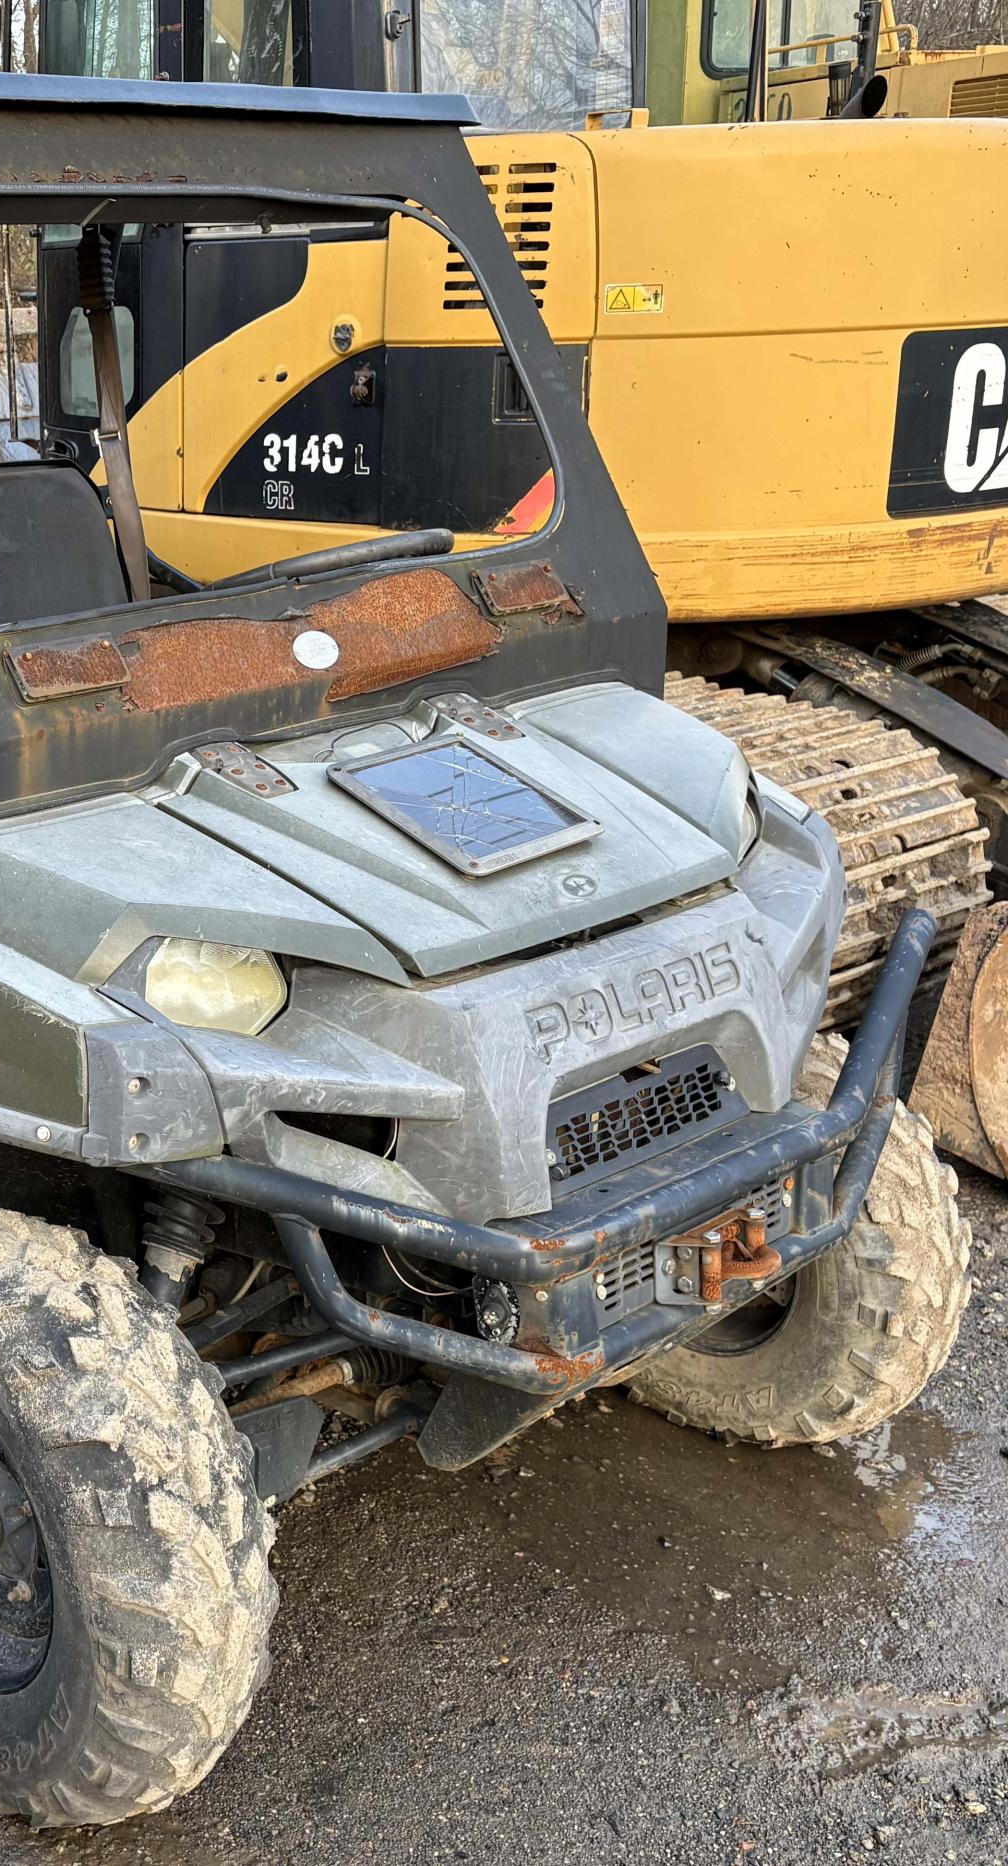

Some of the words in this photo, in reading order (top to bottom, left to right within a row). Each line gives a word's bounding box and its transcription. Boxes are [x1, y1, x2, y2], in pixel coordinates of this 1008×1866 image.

[263, 433, 343, 474] 314C
[354, 443, 370, 475] L
[944, 342, 1008, 493] C
[263, 480, 294, 510] CR
[524, 941, 742, 1065] POLARIS
